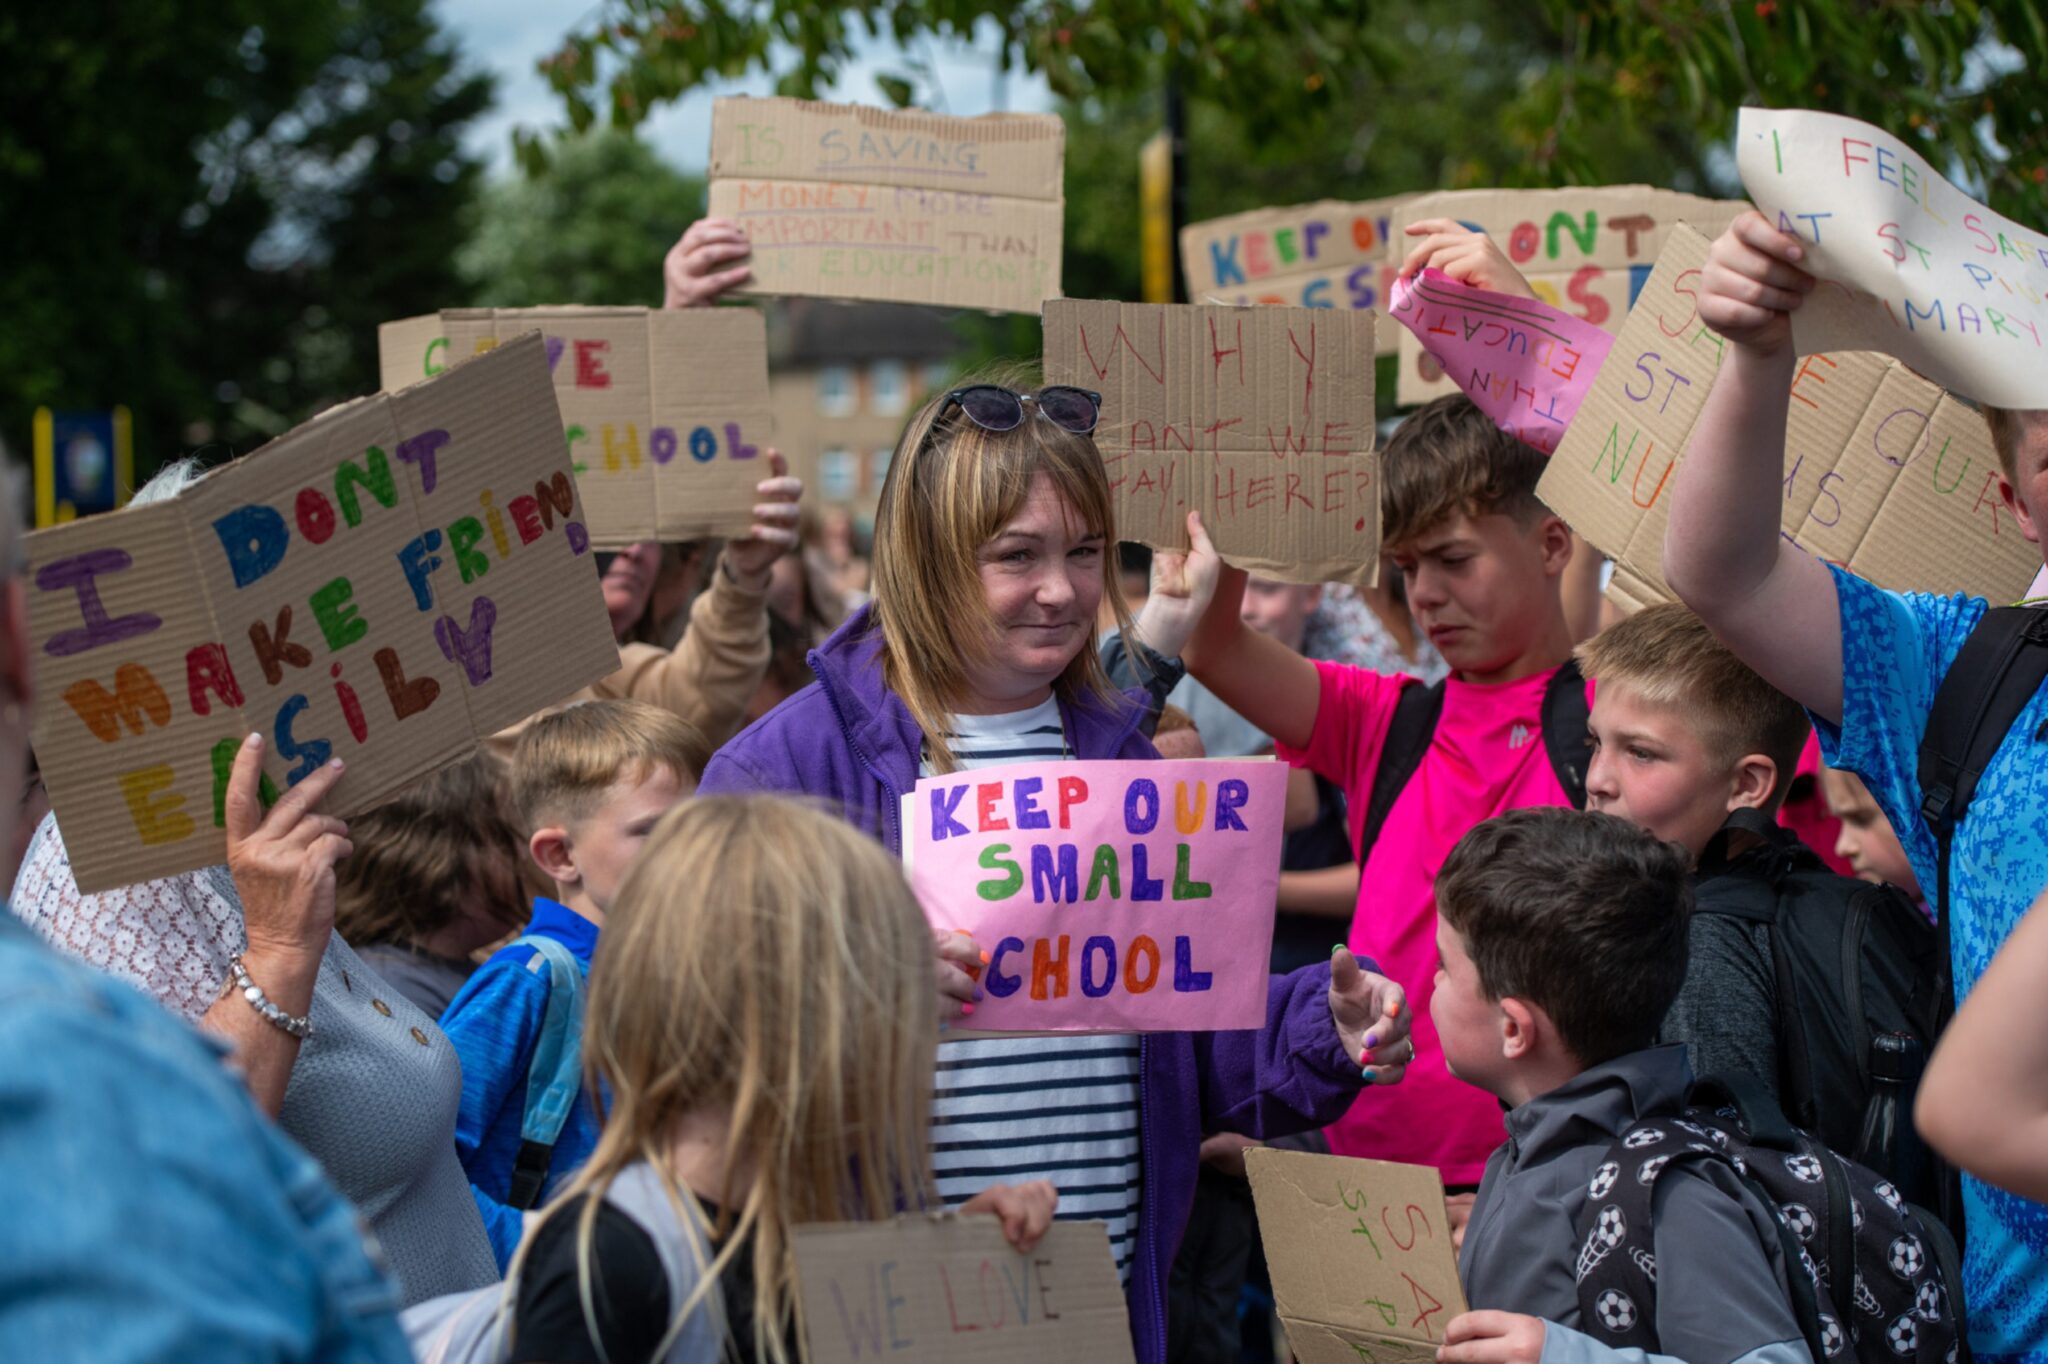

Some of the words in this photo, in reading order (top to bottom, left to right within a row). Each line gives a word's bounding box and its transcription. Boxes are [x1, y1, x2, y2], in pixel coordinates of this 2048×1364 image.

[736, 123, 785, 166] IS
[819, 129, 979, 170] SAVING
[1773, 129, 1783, 174] I
[1842, 137, 1948, 226] FEEL
[739, 181, 870, 209] MONEY
[894, 187, 995, 216] MORE
[746, 215, 933, 243] MPORTANT
[946, 231, 1038, 257] THAN
[1208, 219, 1331, 288] KEEP
[1510, 210, 1656, 264] ONT
[1779, 209, 1833, 244] AT
[1877, 222, 1933, 271] ST
[1904, 299, 2041, 347] MARY
[1080, 311, 1316, 419] WHY
[566, 422, 759, 474] CHOOL
[1098, 415, 1242, 466] ANT
[1267, 421, 1353, 460] WE
[35, 548, 163, 657] I
[211, 429, 451, 589] DONT
[61, 576, 368, 743] MAKE
[117, 595, 497, 846] EASiLY
[930, 776, 1090, 842] KEEP
[1123, 778, 1250, 835] OUR
[975, 843, 1213, 904] SMALL
[828, 1261, 914, 1361] WE
[939, 1248, 1061, 1334] LOVE
